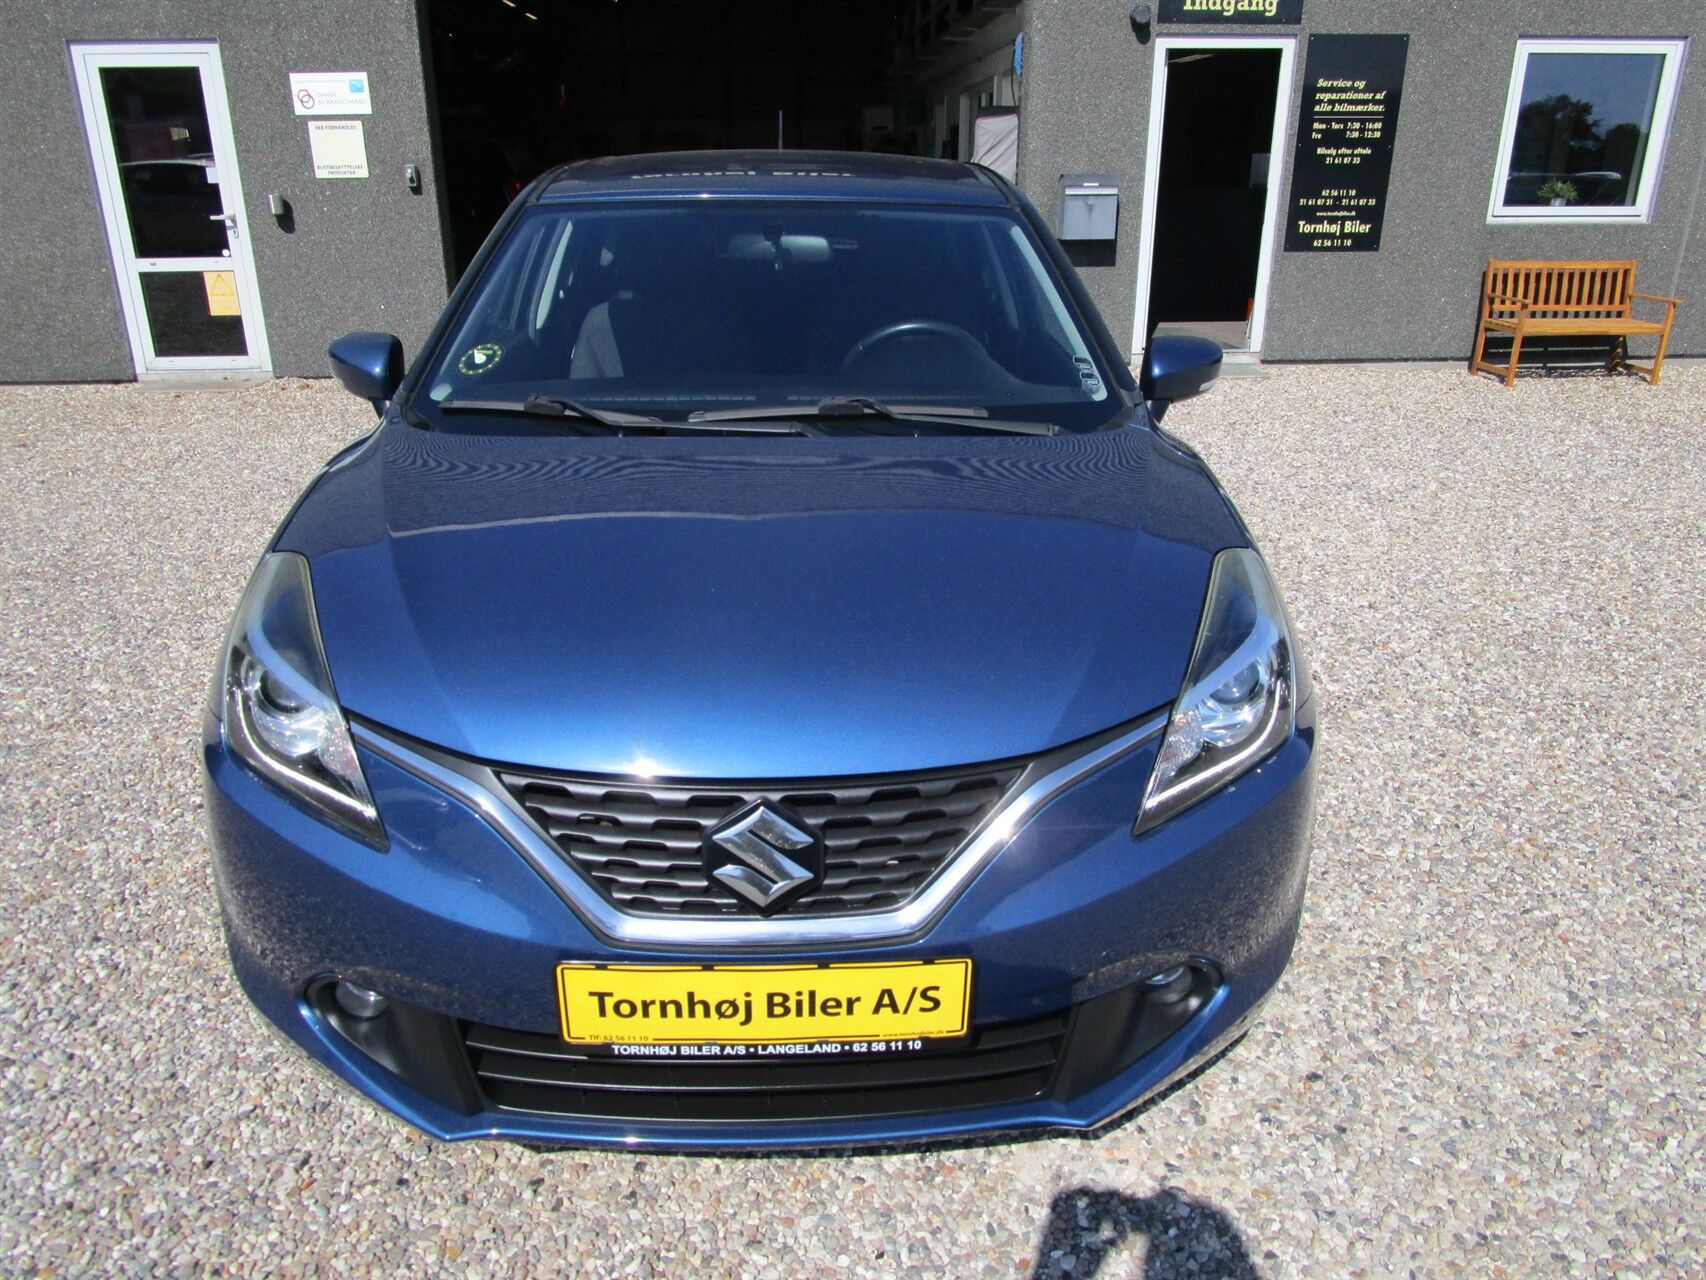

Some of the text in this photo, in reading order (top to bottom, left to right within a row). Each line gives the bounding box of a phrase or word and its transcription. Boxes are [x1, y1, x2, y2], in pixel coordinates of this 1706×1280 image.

[1183, 0, 1278, 16] Indgang
[1317, 79, 1366, 90] Service og
[1315, 91, 1386, 101] reparationer af
[1314, 102, 1386, 112] alle bilmærker.
[1316, 147, 1336, 155] Bilsalg
[1298, 220, 1372, 236] Tornhøj Biler
[588, 985, 941, 1026] Tornhøj Biler A/S
[612, 1040, 922, 1055] TORNHØJ BILER A/S LANGELAND 62 56 11 10
